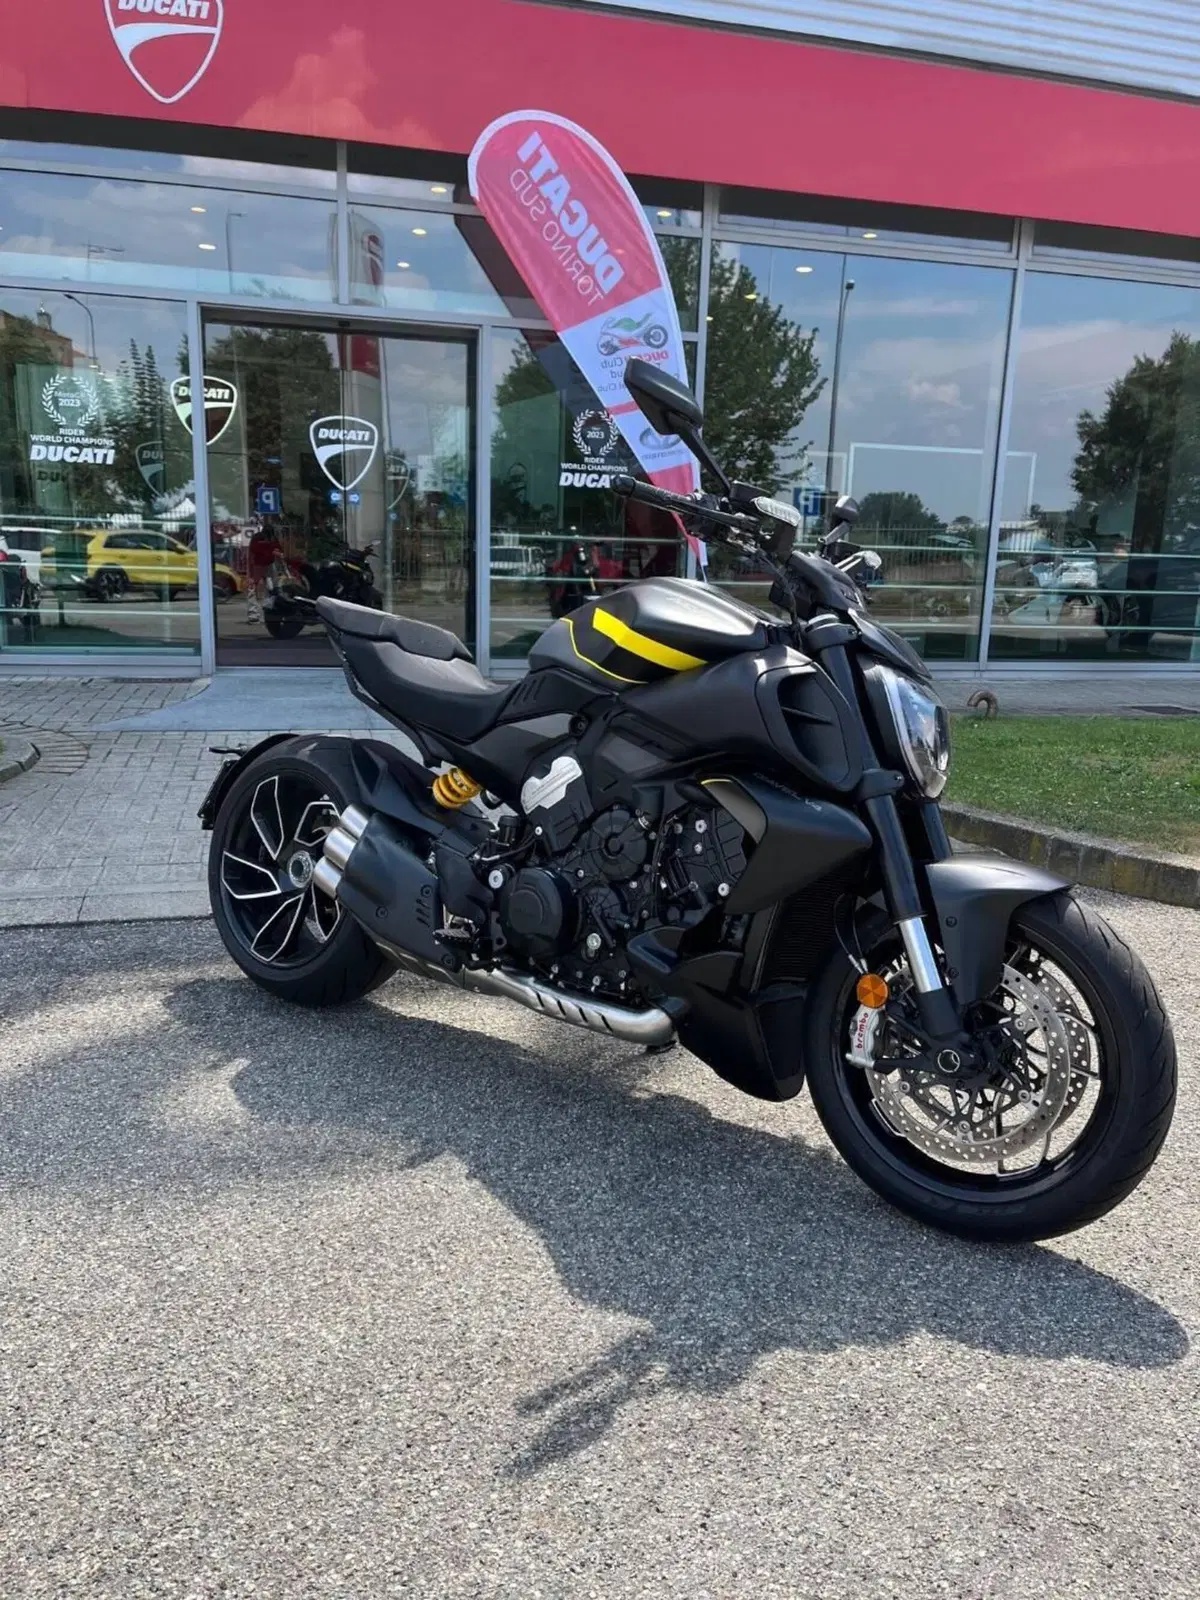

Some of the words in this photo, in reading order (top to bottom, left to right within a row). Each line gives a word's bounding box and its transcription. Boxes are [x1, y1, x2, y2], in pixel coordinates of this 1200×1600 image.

[118, 0, 210, 19] DUCATI
[178, 386, 230, 399] DATI
[58, 398, 80, 407] 2023
[59, 428, 85, 436] RIDER
[318, 428, 371, 441] DUCATI
[586, 430, 605, 439] 2023
[30, 434, 62, 443] WORLD
[64, 436, 115, 447] CHAMPIONS
[30, 444, 116, 465] DUCATI
[561, 462, 587, 471] WORLD
[587, 463, 628, 473] CHAMPIONS
[559, 472, 616, 488] DUCA
[856, 1012, 869, 1049] brembo
